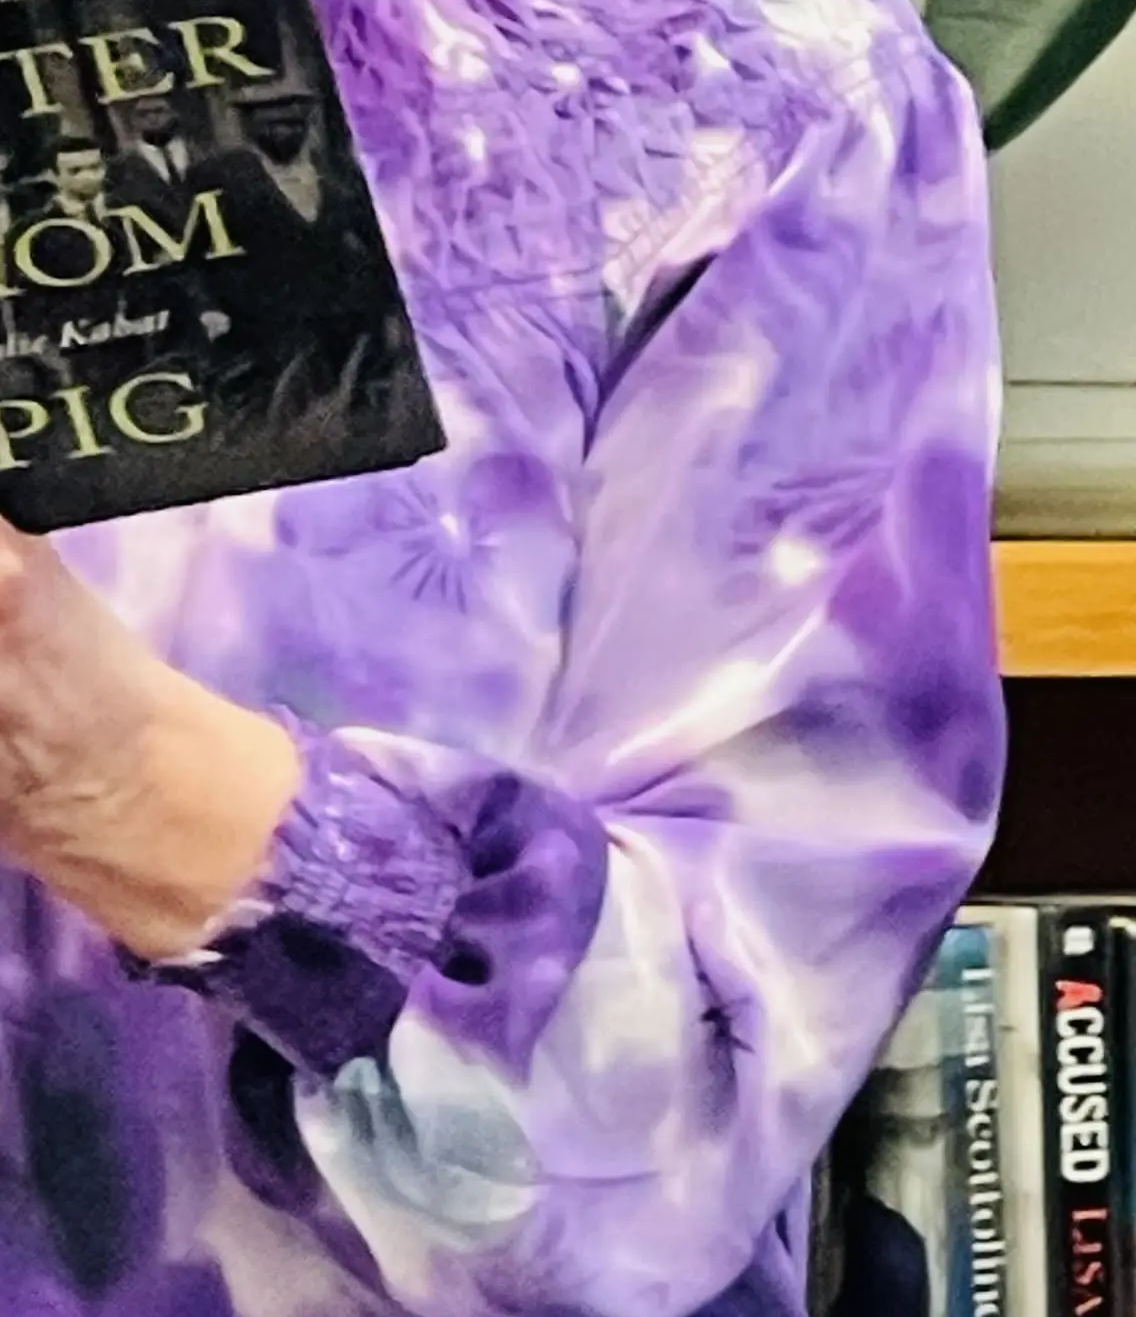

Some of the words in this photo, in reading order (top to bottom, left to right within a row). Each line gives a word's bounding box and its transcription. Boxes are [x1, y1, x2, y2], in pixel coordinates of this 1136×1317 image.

[60, 310, 171, 349] Kabat
[1056, 980, 1109, 1182] ACCUSED
[1071, 1208, 1108, 1316] LISA
